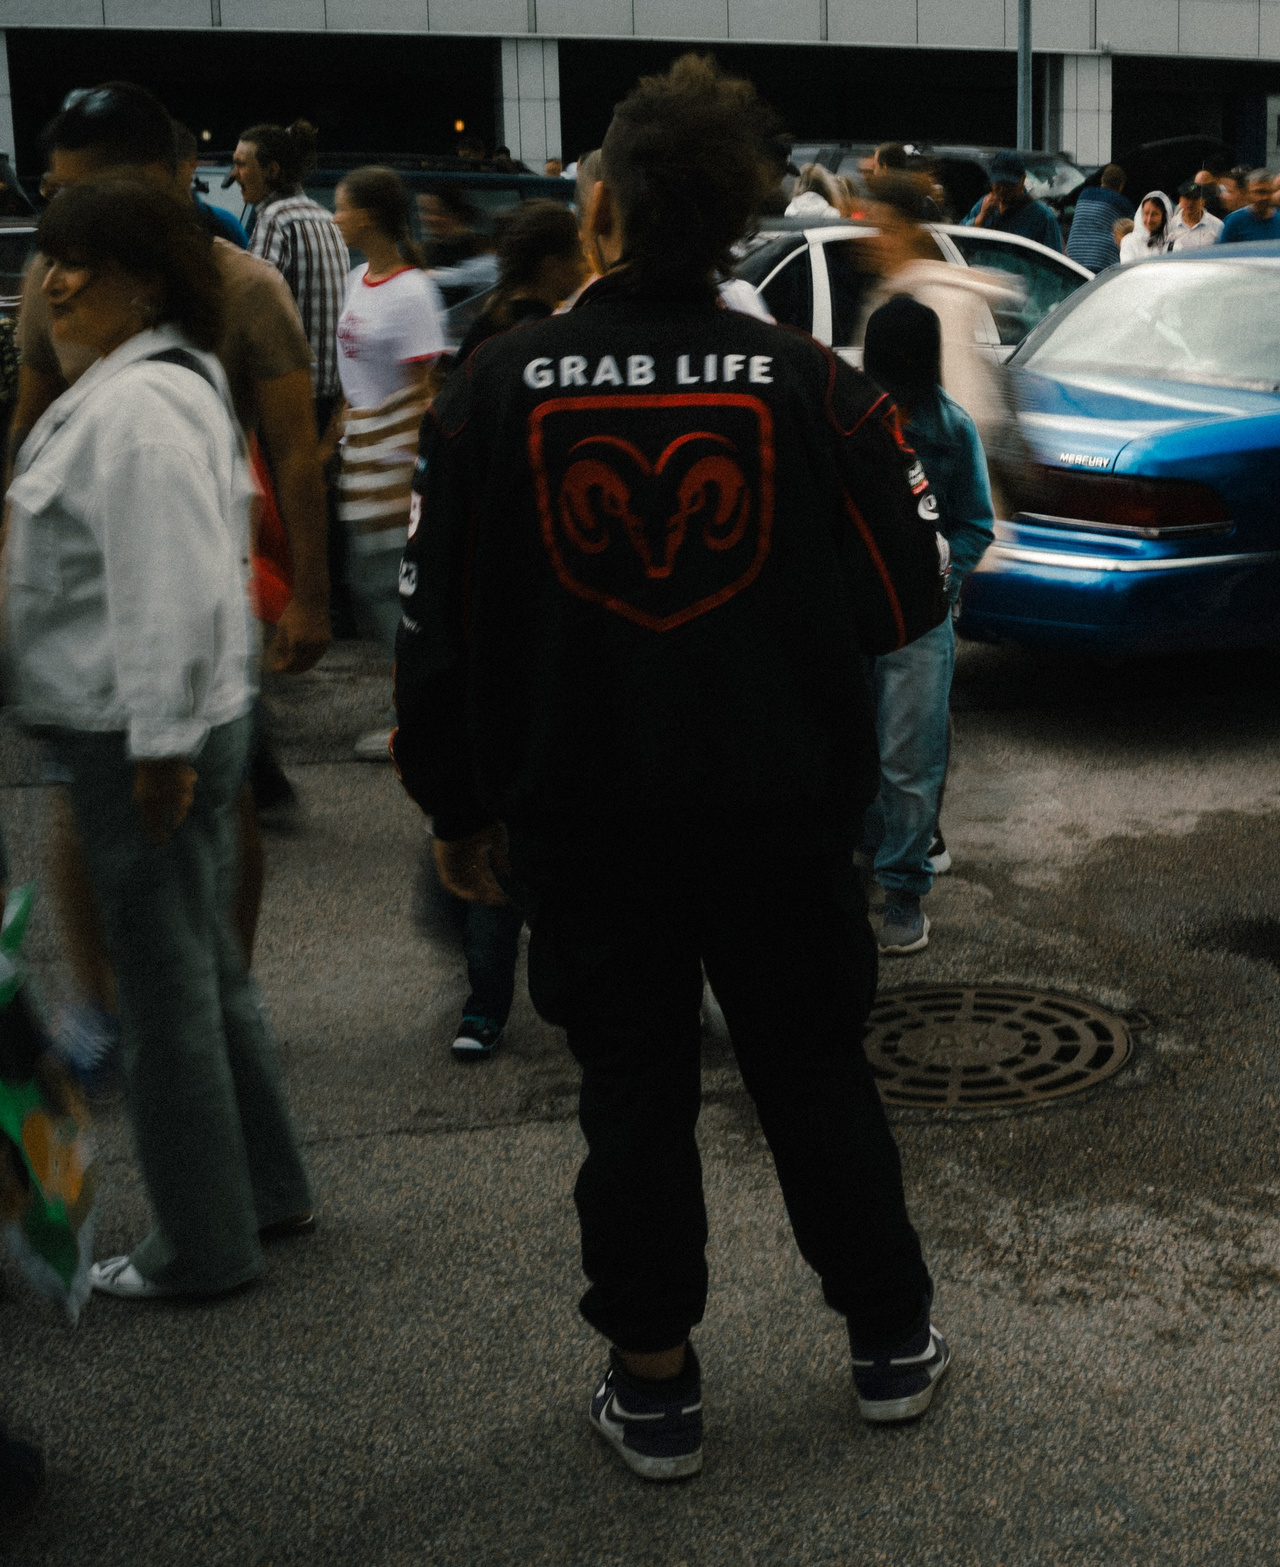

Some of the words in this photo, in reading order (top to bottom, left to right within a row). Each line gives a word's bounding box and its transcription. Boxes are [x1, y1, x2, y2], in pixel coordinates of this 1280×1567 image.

[523, 355, 656, 389] GRAB
[676, 354, 774, 385] LIFE
[1060, 452, 1110, 468] MERCURY
